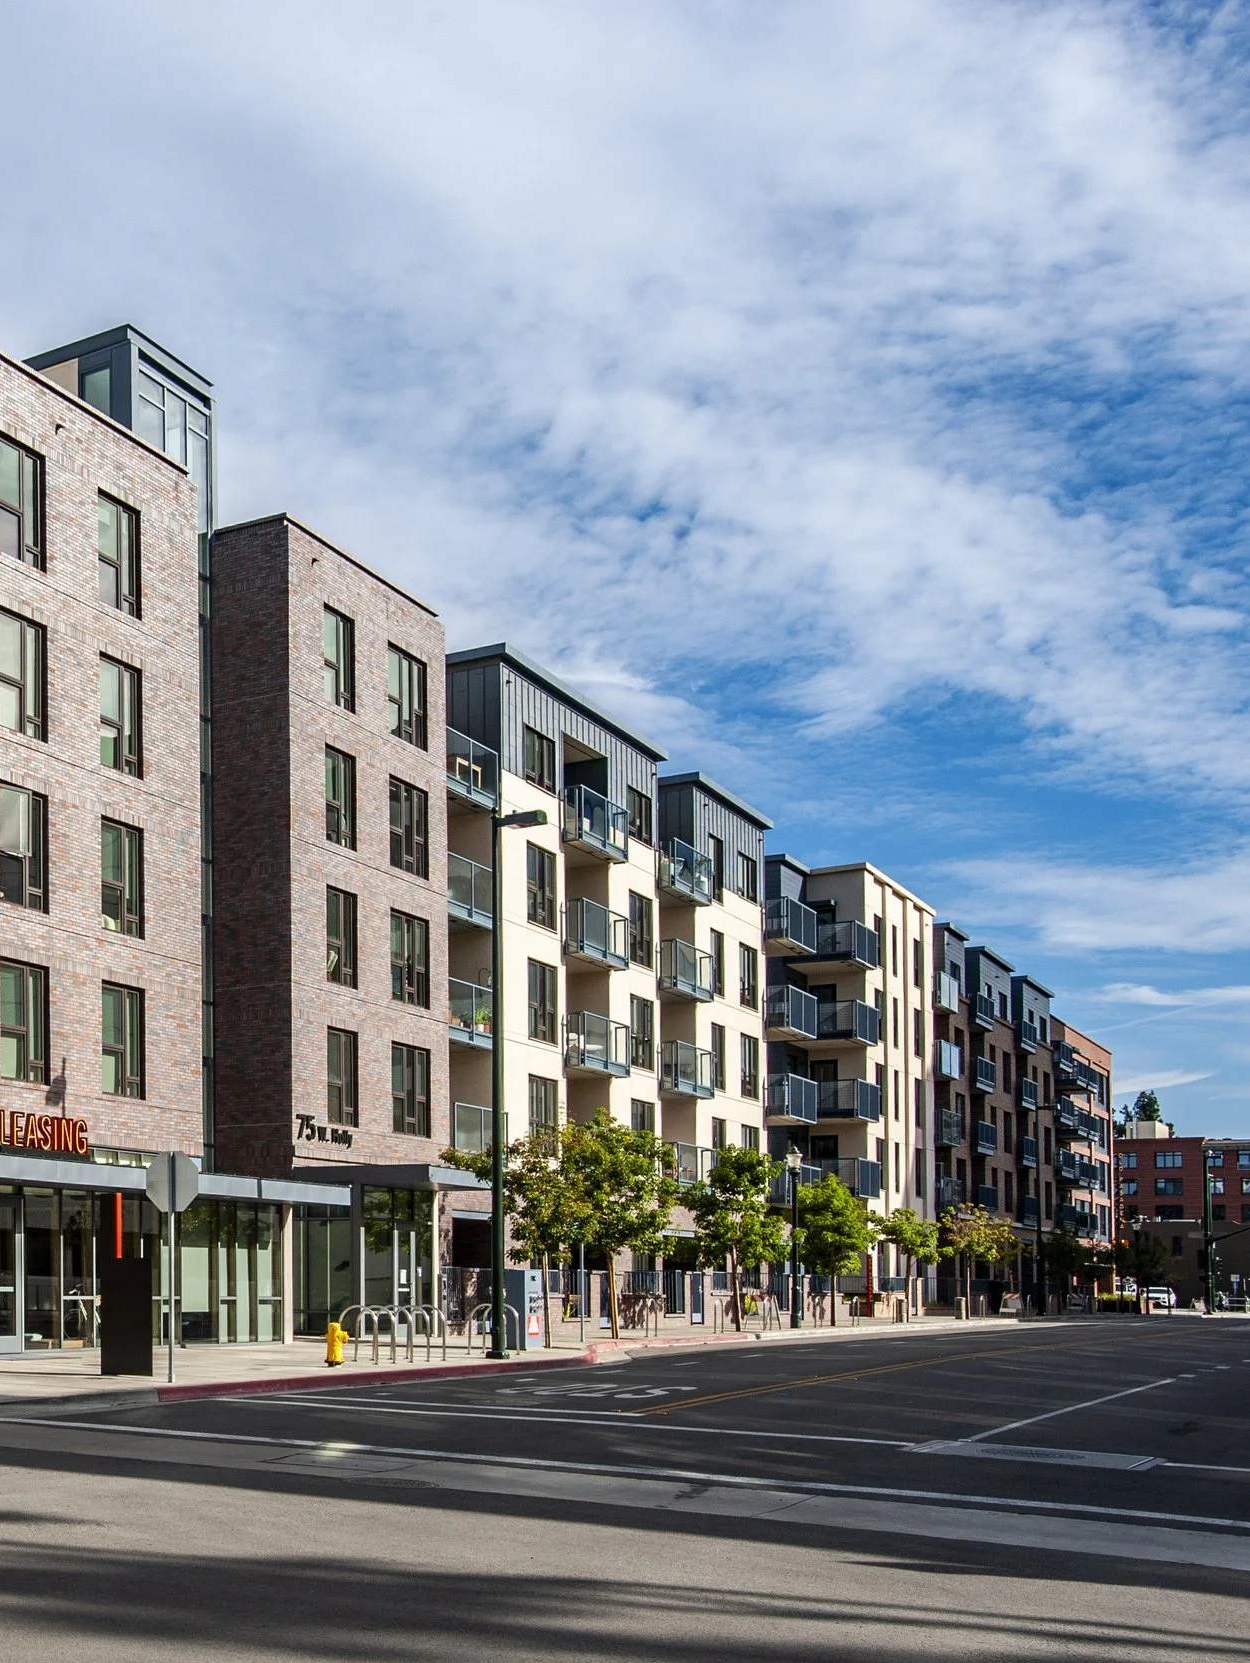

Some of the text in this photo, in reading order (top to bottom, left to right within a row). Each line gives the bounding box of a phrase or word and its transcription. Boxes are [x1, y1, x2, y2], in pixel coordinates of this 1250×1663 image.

[295, 1113, 353, 1150] 75 W. Holly
